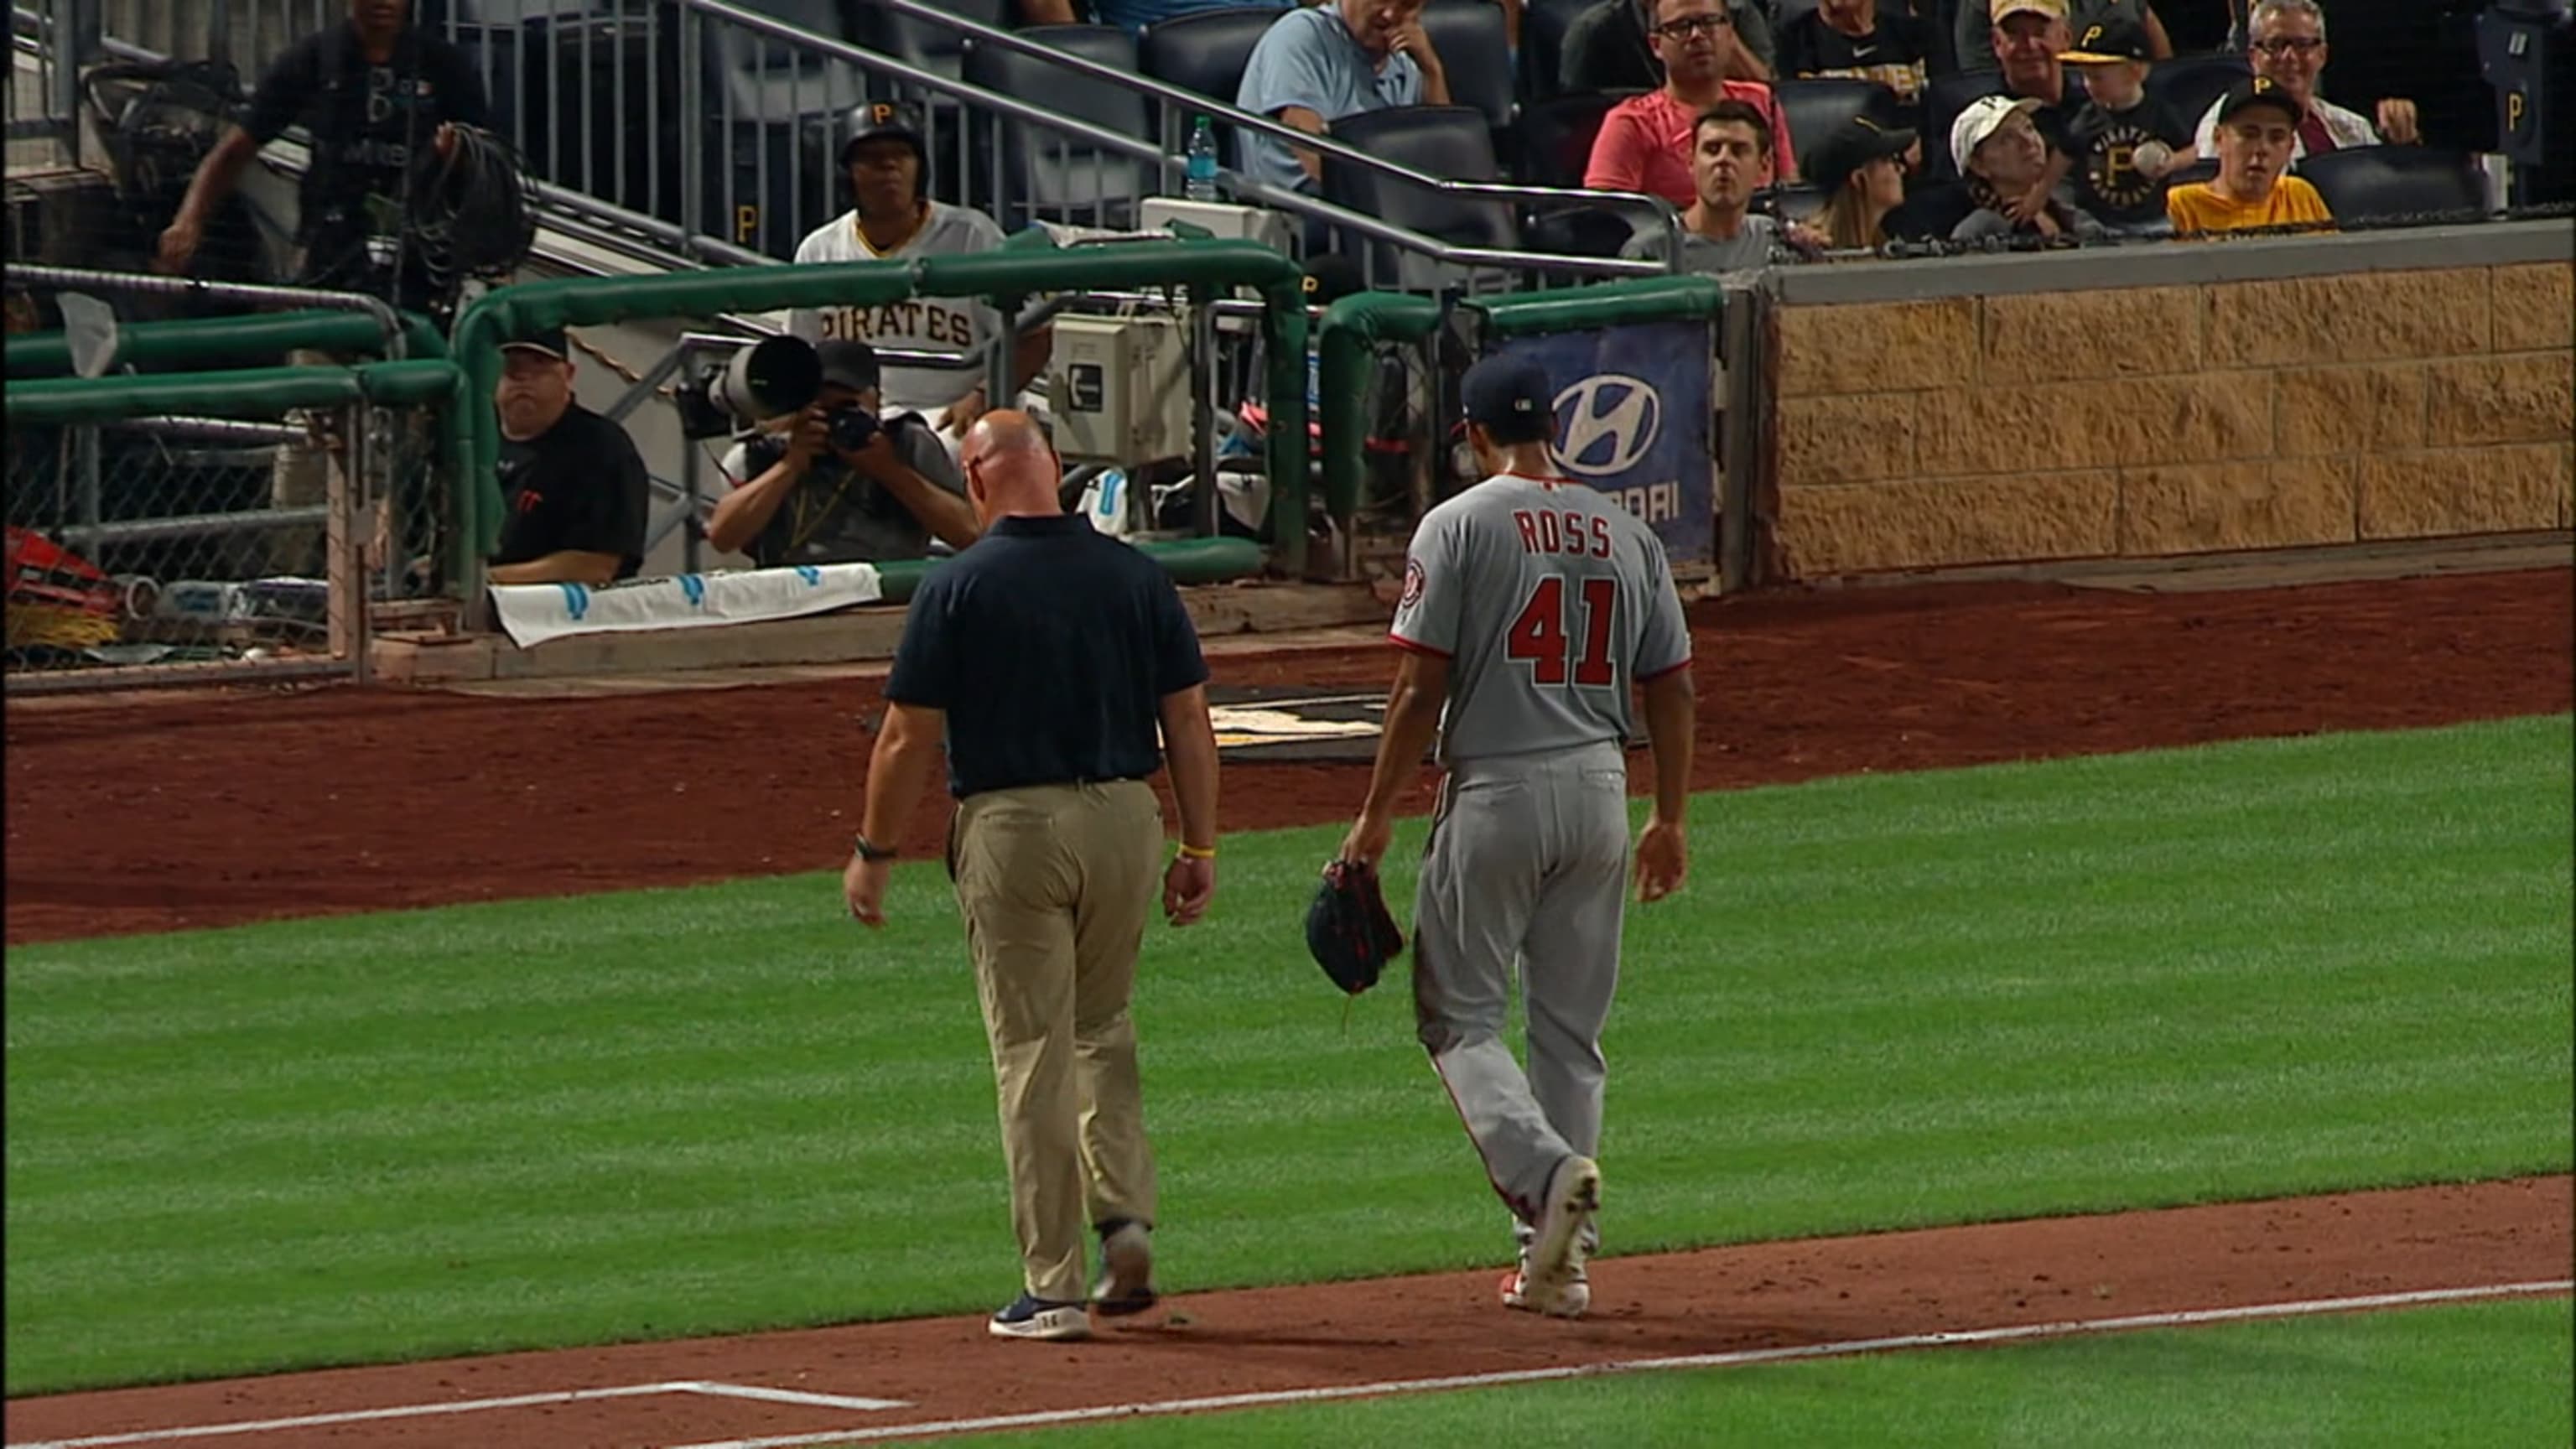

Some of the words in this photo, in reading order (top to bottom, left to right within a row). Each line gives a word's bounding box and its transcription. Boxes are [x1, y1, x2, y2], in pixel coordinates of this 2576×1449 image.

[2081, 26, 2102, 48] P
[2255, 76, 2272, 95] P
[871, 103, 892, 124] P
[2509, 92, 2522, 132] P
[2106, 147, 2135, 186] P
[737, 205, 756, 243] P
[1513, 507, 1613, 559] ROSS
[1504, 574, 1617, 687] 41
